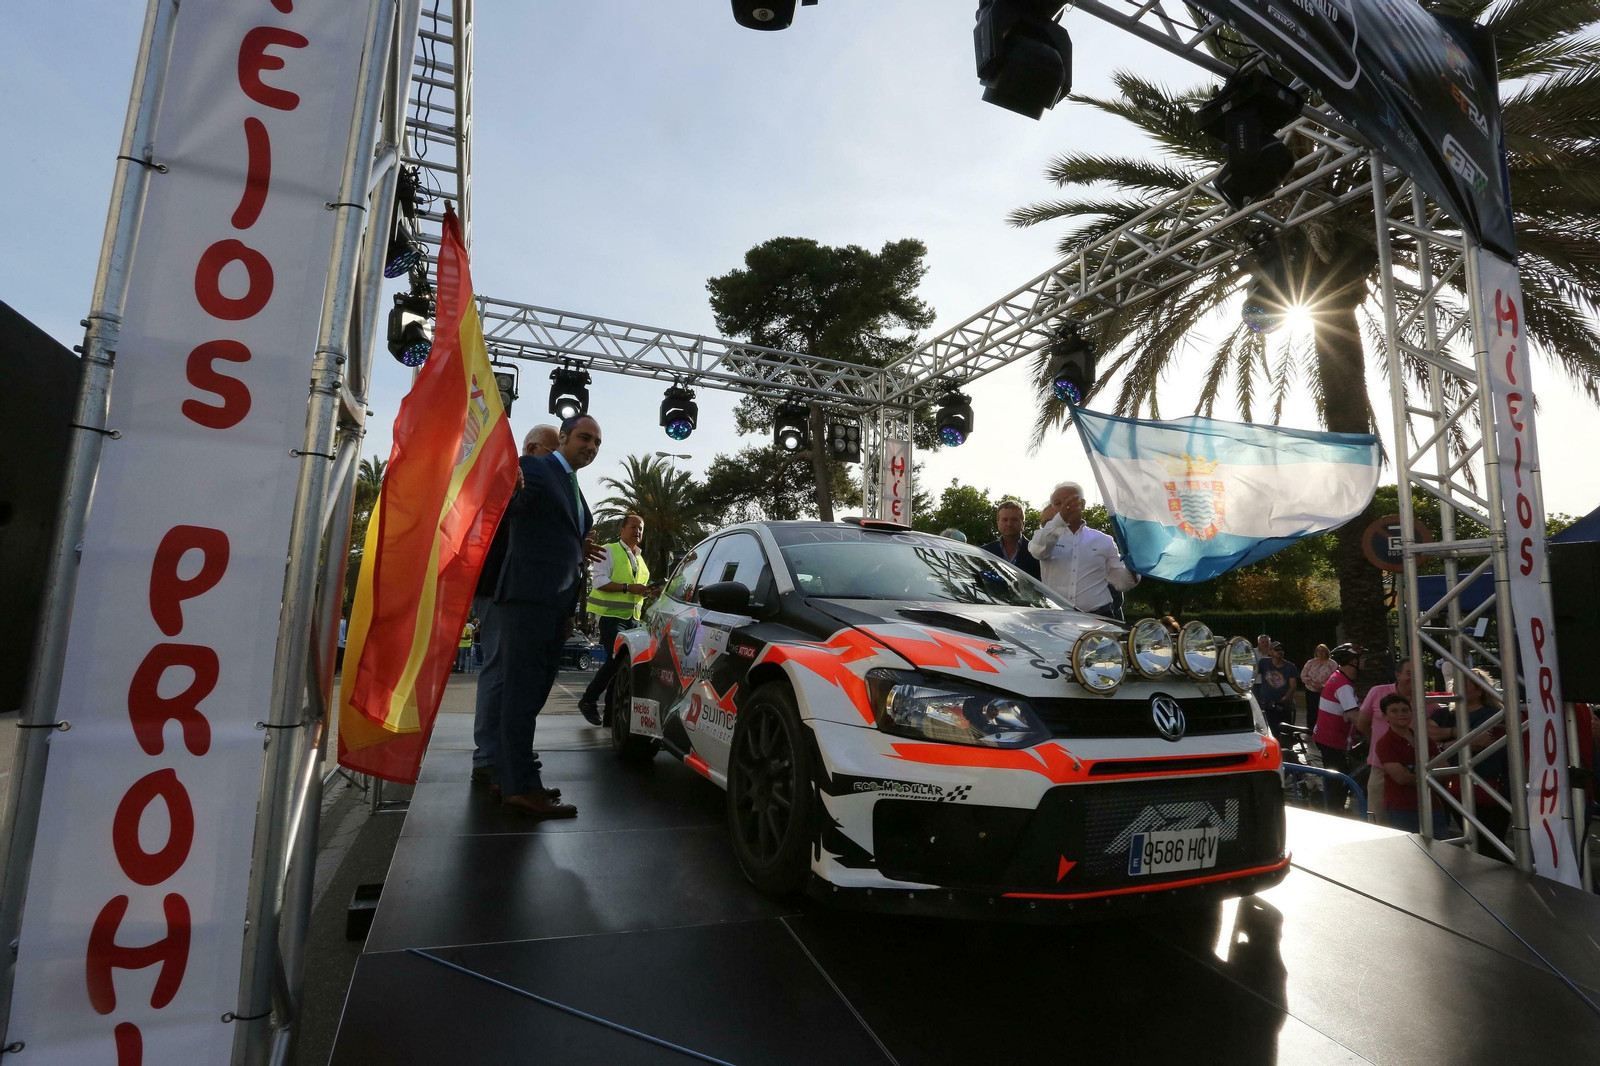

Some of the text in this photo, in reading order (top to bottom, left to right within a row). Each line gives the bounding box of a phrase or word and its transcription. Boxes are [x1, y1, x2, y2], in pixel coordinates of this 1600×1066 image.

[1530, 617, 1558, 869] PROHI
[877, 792, 938, 801] motorsport
[1143, 836, 1217, 866] 9586 HCV
[1132, 858, 1140, 867] E
